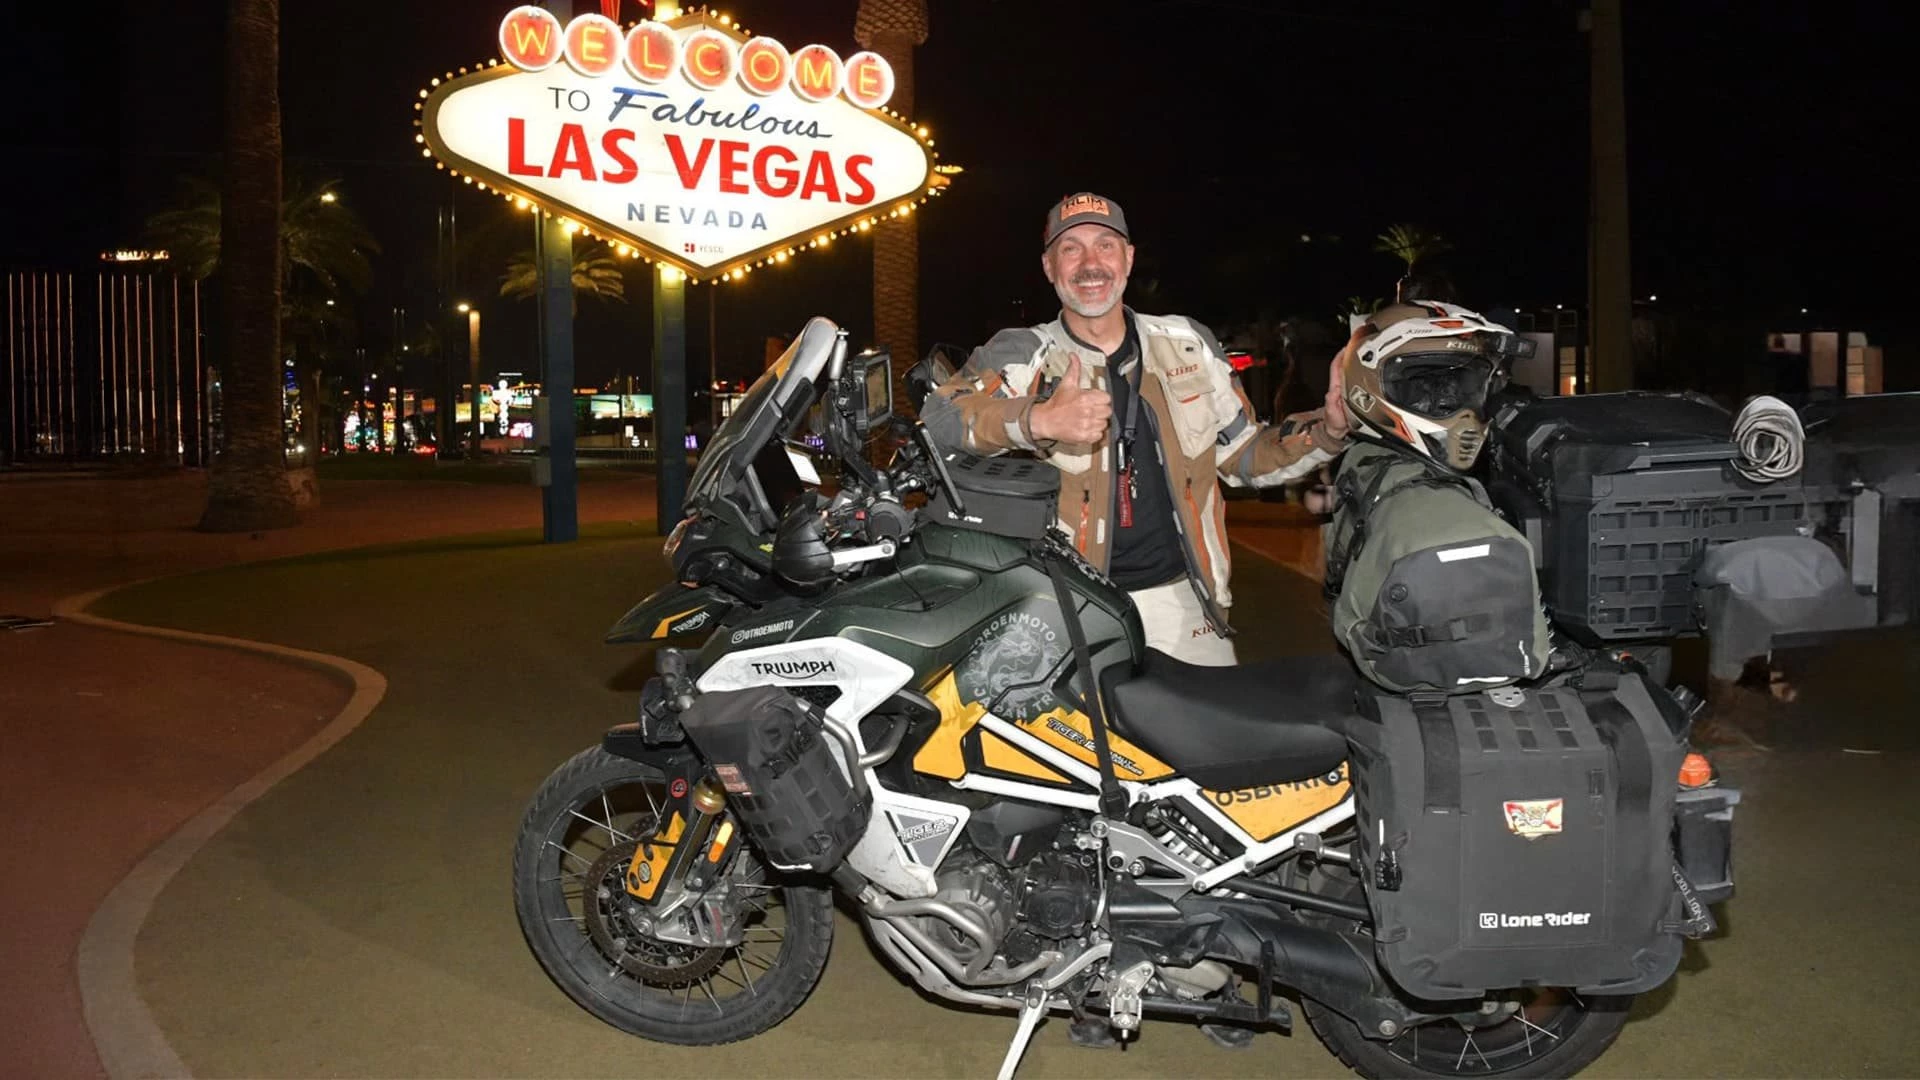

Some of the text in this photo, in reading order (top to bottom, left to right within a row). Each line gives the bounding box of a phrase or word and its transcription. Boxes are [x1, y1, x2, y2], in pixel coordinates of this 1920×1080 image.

[511, 20, 881, 98] WELCOME
[548, 86, 833, 138] TO Fabulous
[507, 117, 876, 205] LAS VEGAS
[626, 202, 768, 231] NEVADA
[672, 611, 711, 633] TRIUMPH
[752, 660, 836, 677] TRIUMPH
[1048, 718, 1086, 745] TIGER
[1501, 913, 1543, 927] Lone
[1544, 911, 1591, 926] Rider
